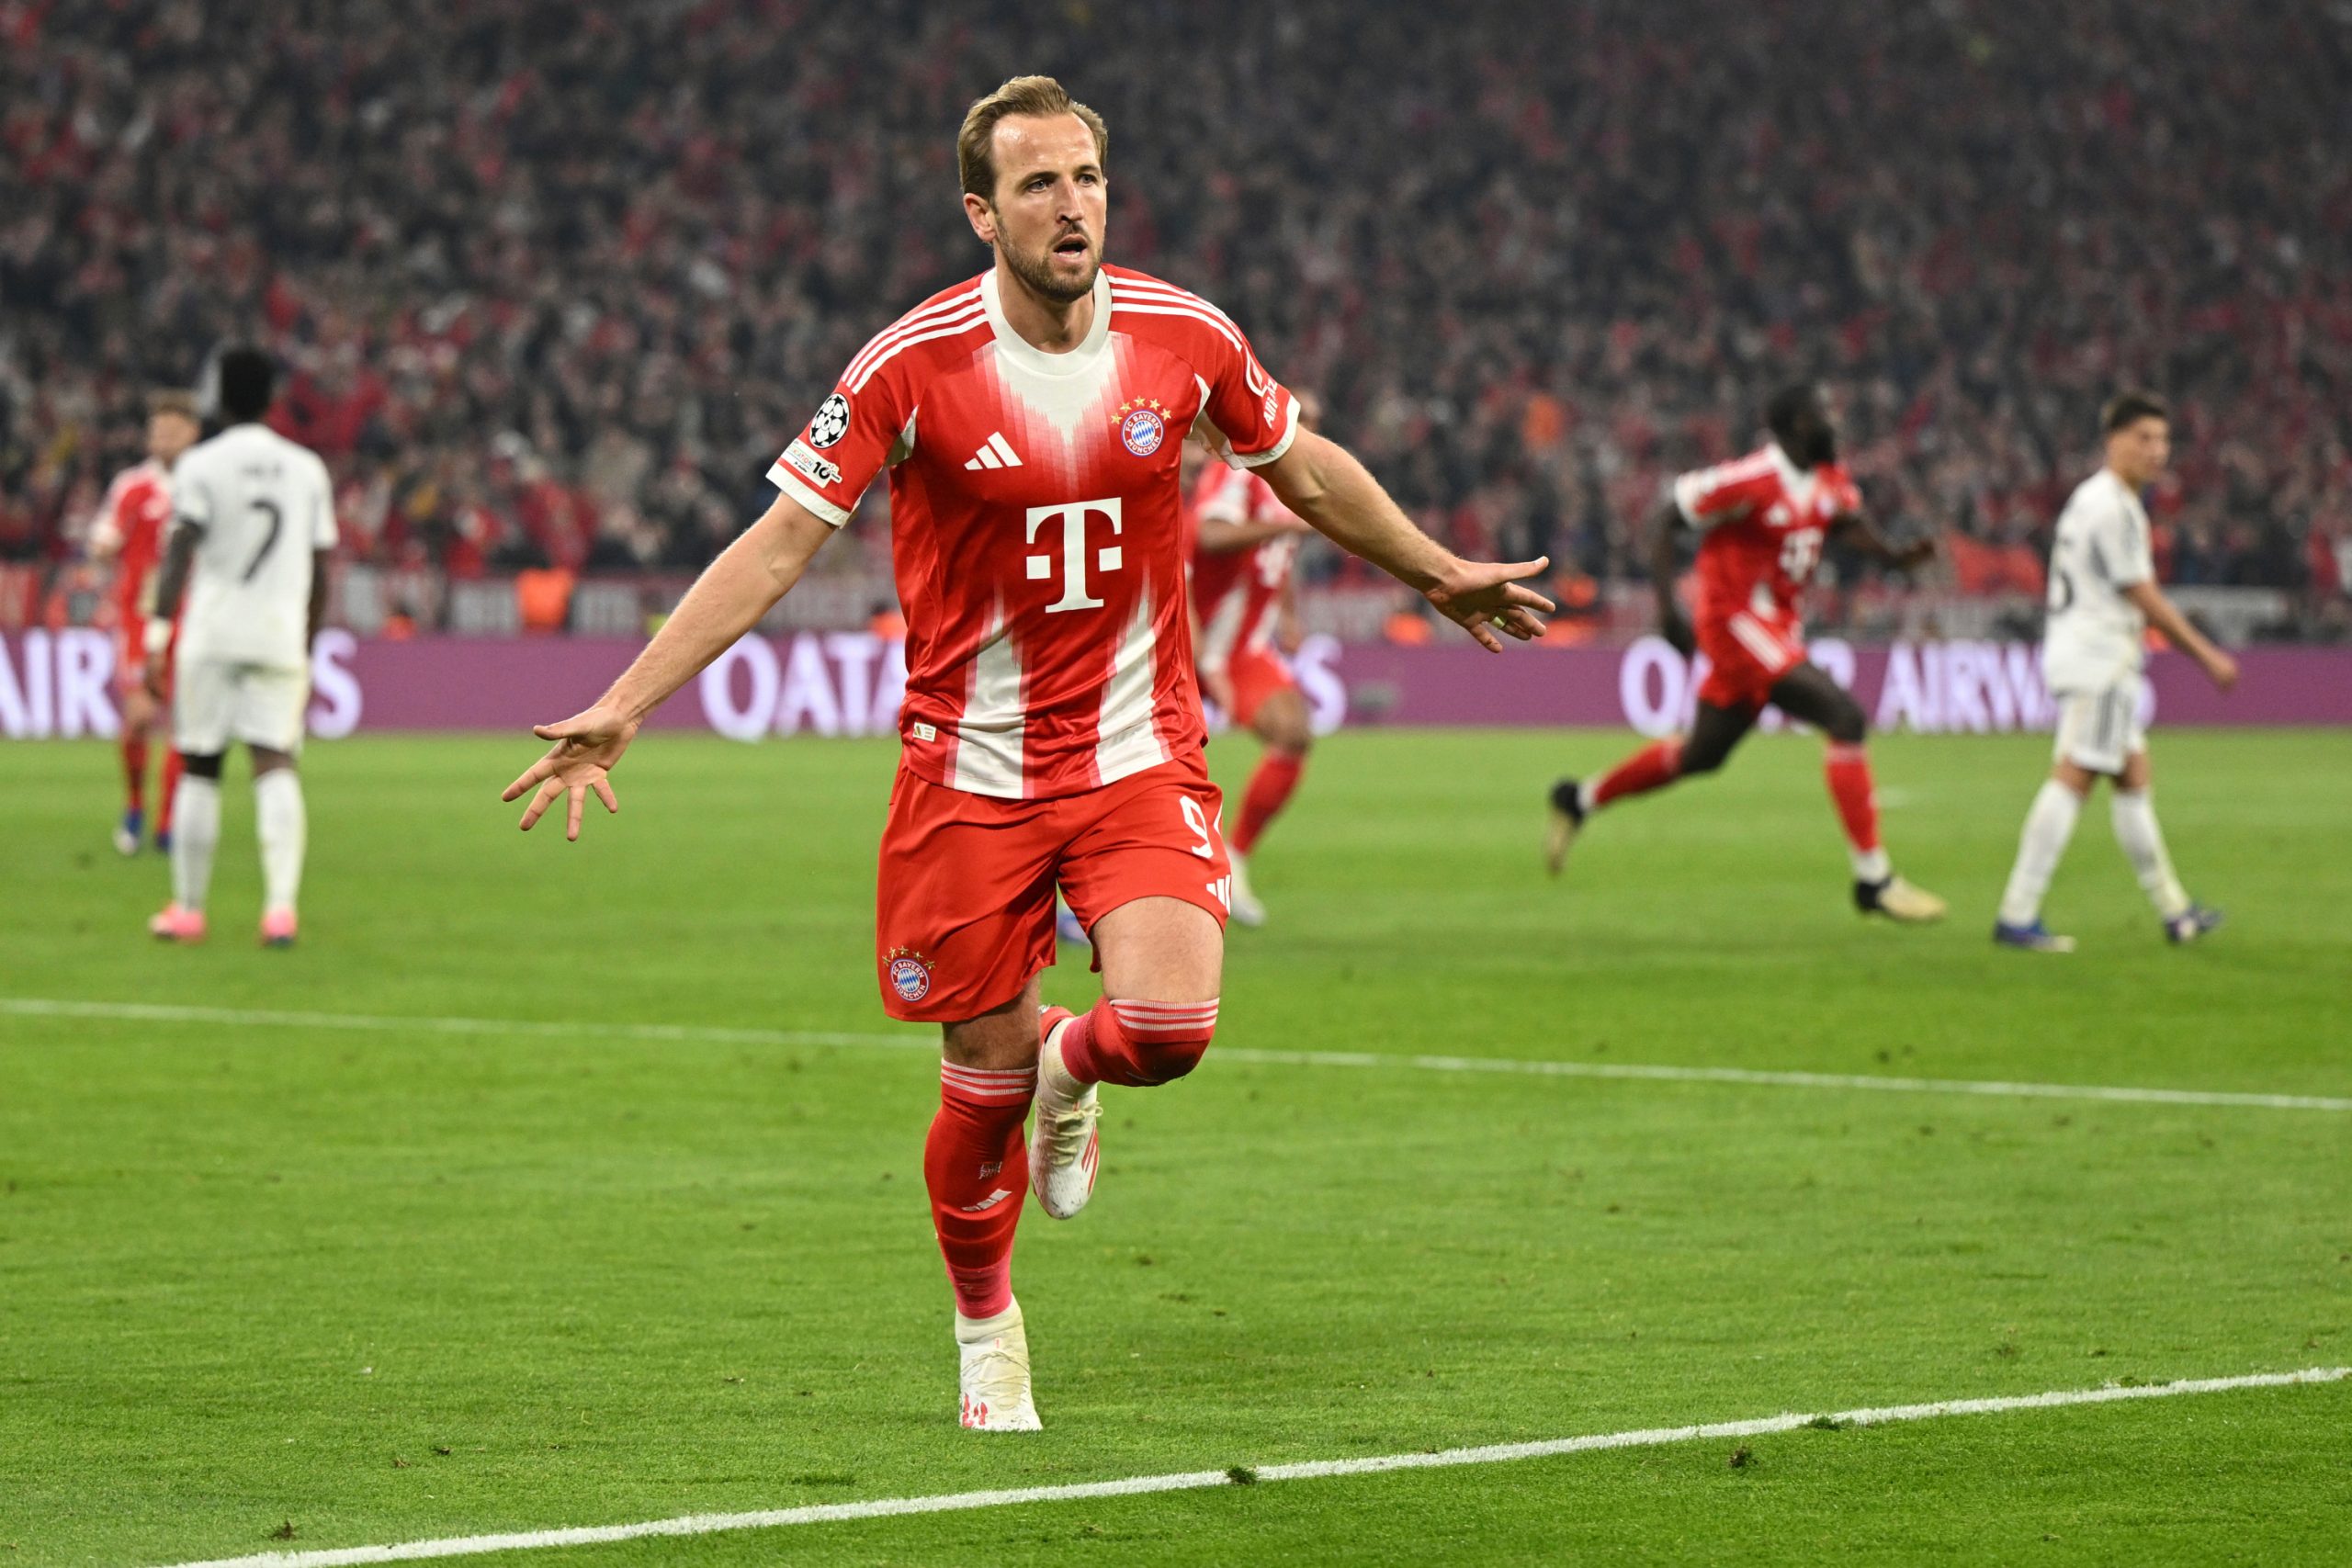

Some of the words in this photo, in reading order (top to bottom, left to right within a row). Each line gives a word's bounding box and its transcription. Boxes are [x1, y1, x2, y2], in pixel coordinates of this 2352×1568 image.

[1125, 421, 1134, 432] FC
[1133, 413, 1160, 430] BAYERN
[242, 497, 285, 584] 7
[1026, 496, 1123, 614] T
[1179, 795, 1214, 859] 9
[898, 962, 924, 978] BAYERN
